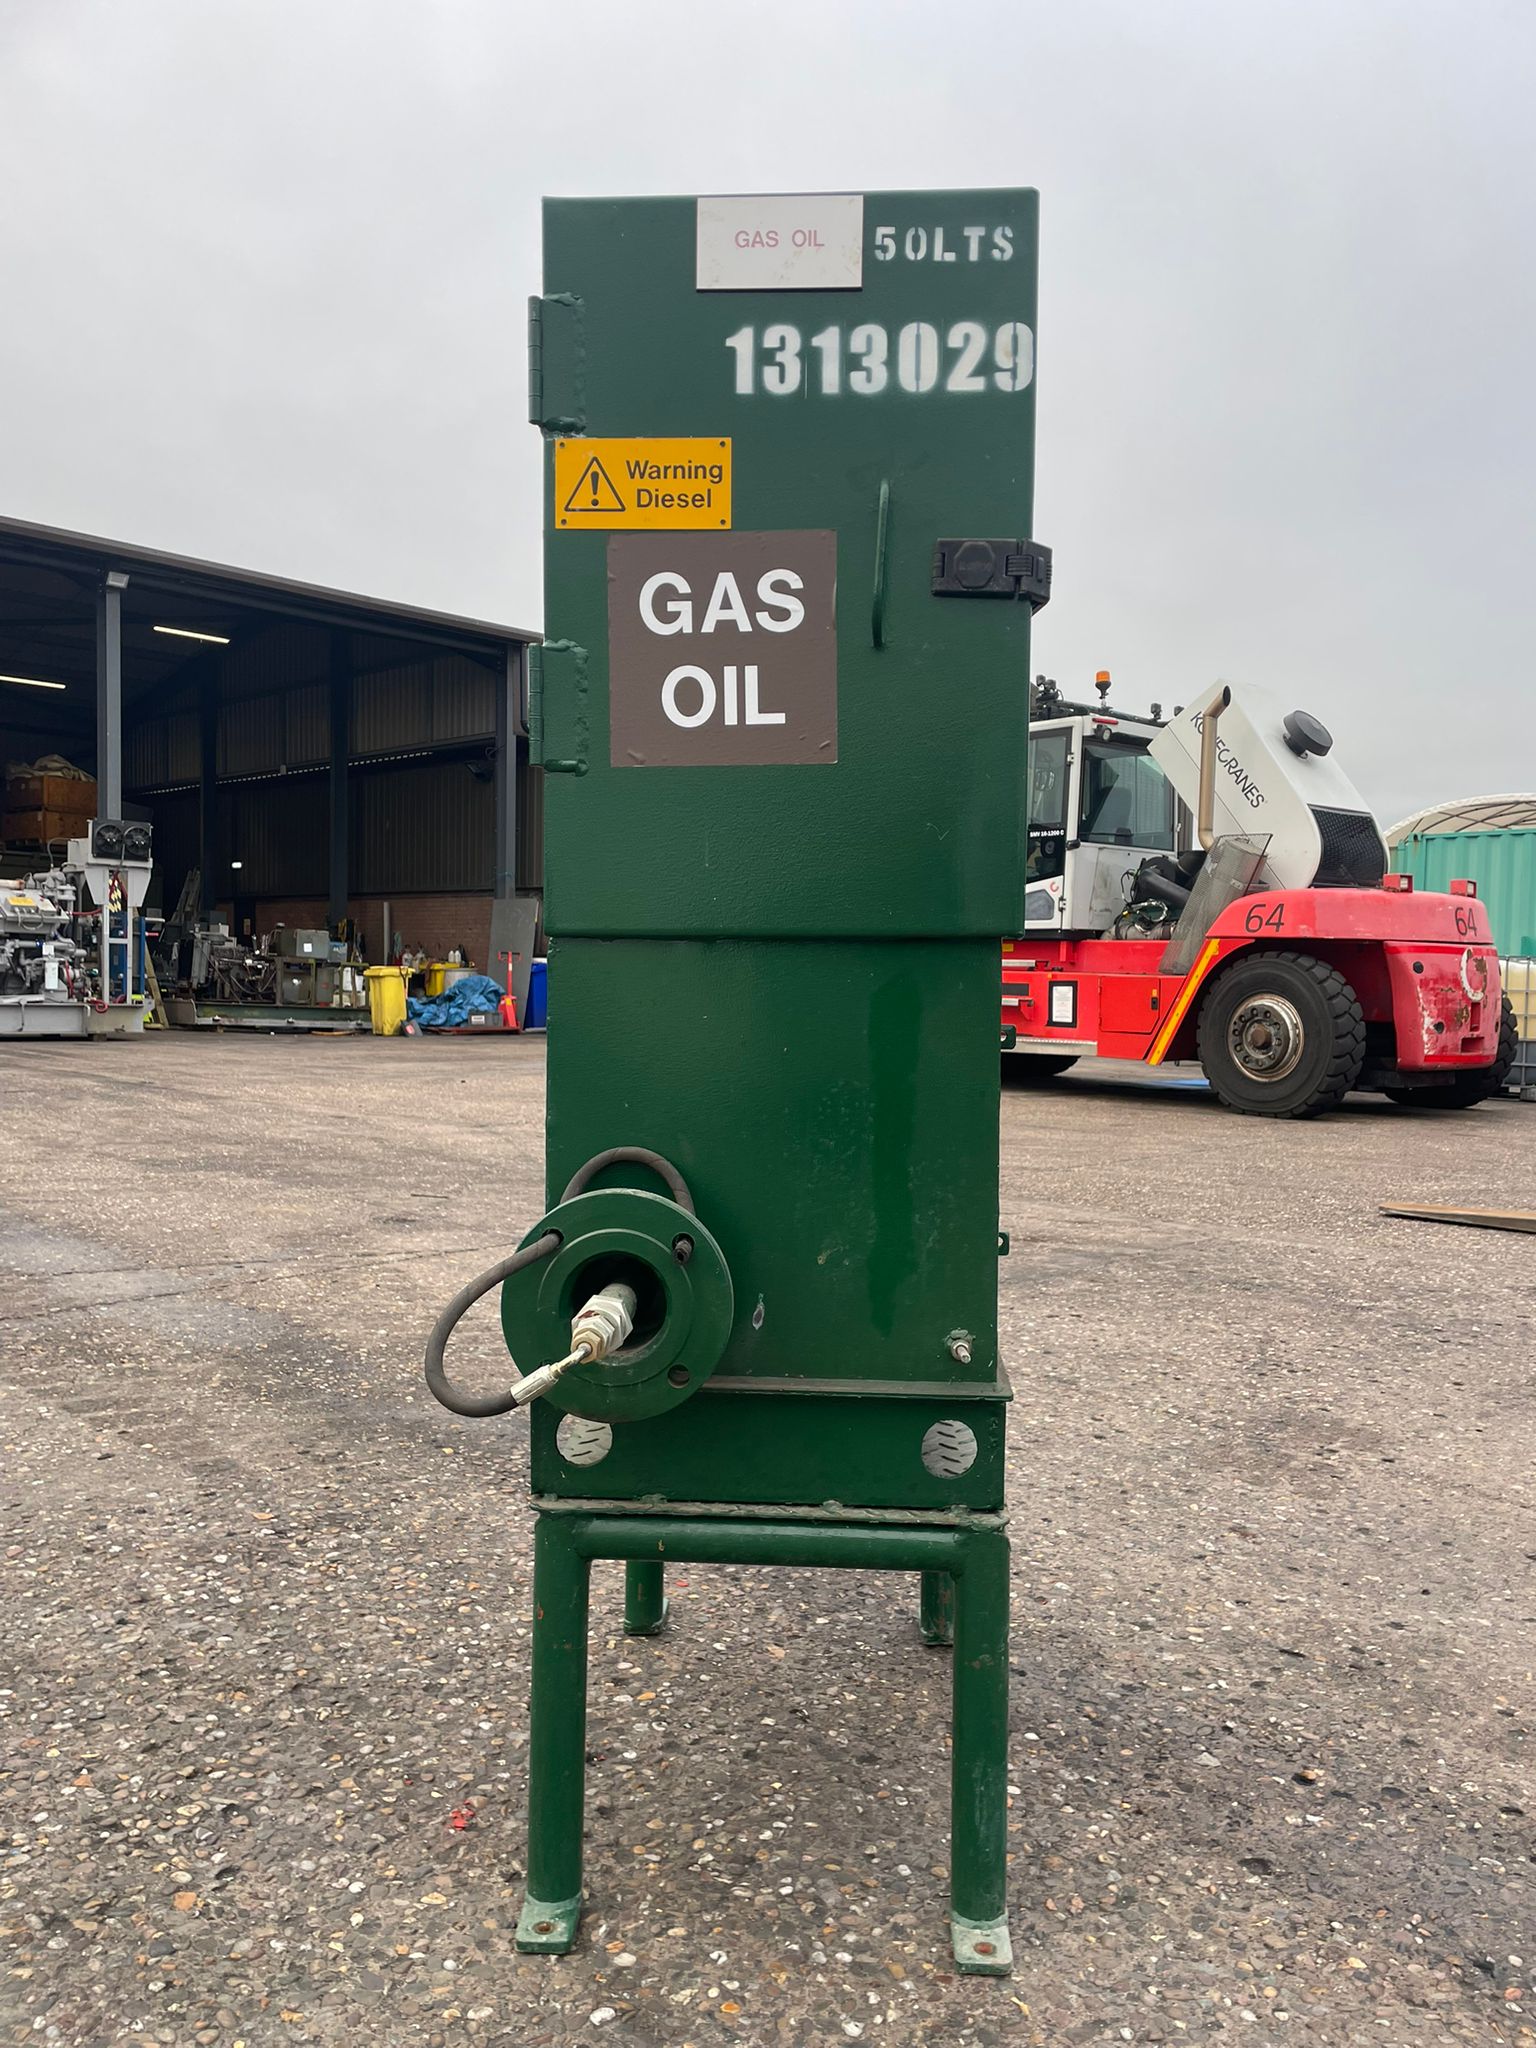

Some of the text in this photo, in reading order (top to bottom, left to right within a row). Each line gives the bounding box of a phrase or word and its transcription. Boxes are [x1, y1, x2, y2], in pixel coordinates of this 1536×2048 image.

[735, 229, 825, 248] GAS OIL
[725, 321, 1033, 395] 1313029
[626, 459, 724, 484] Warning
[635, 488, 713, 509] Diesel
[638, 568, 806, 637] GAS
[660, 664, 787, 729] OIL
[1245, 903, 1285, 933] 64
[1455, 907, 1477, 937] 64
